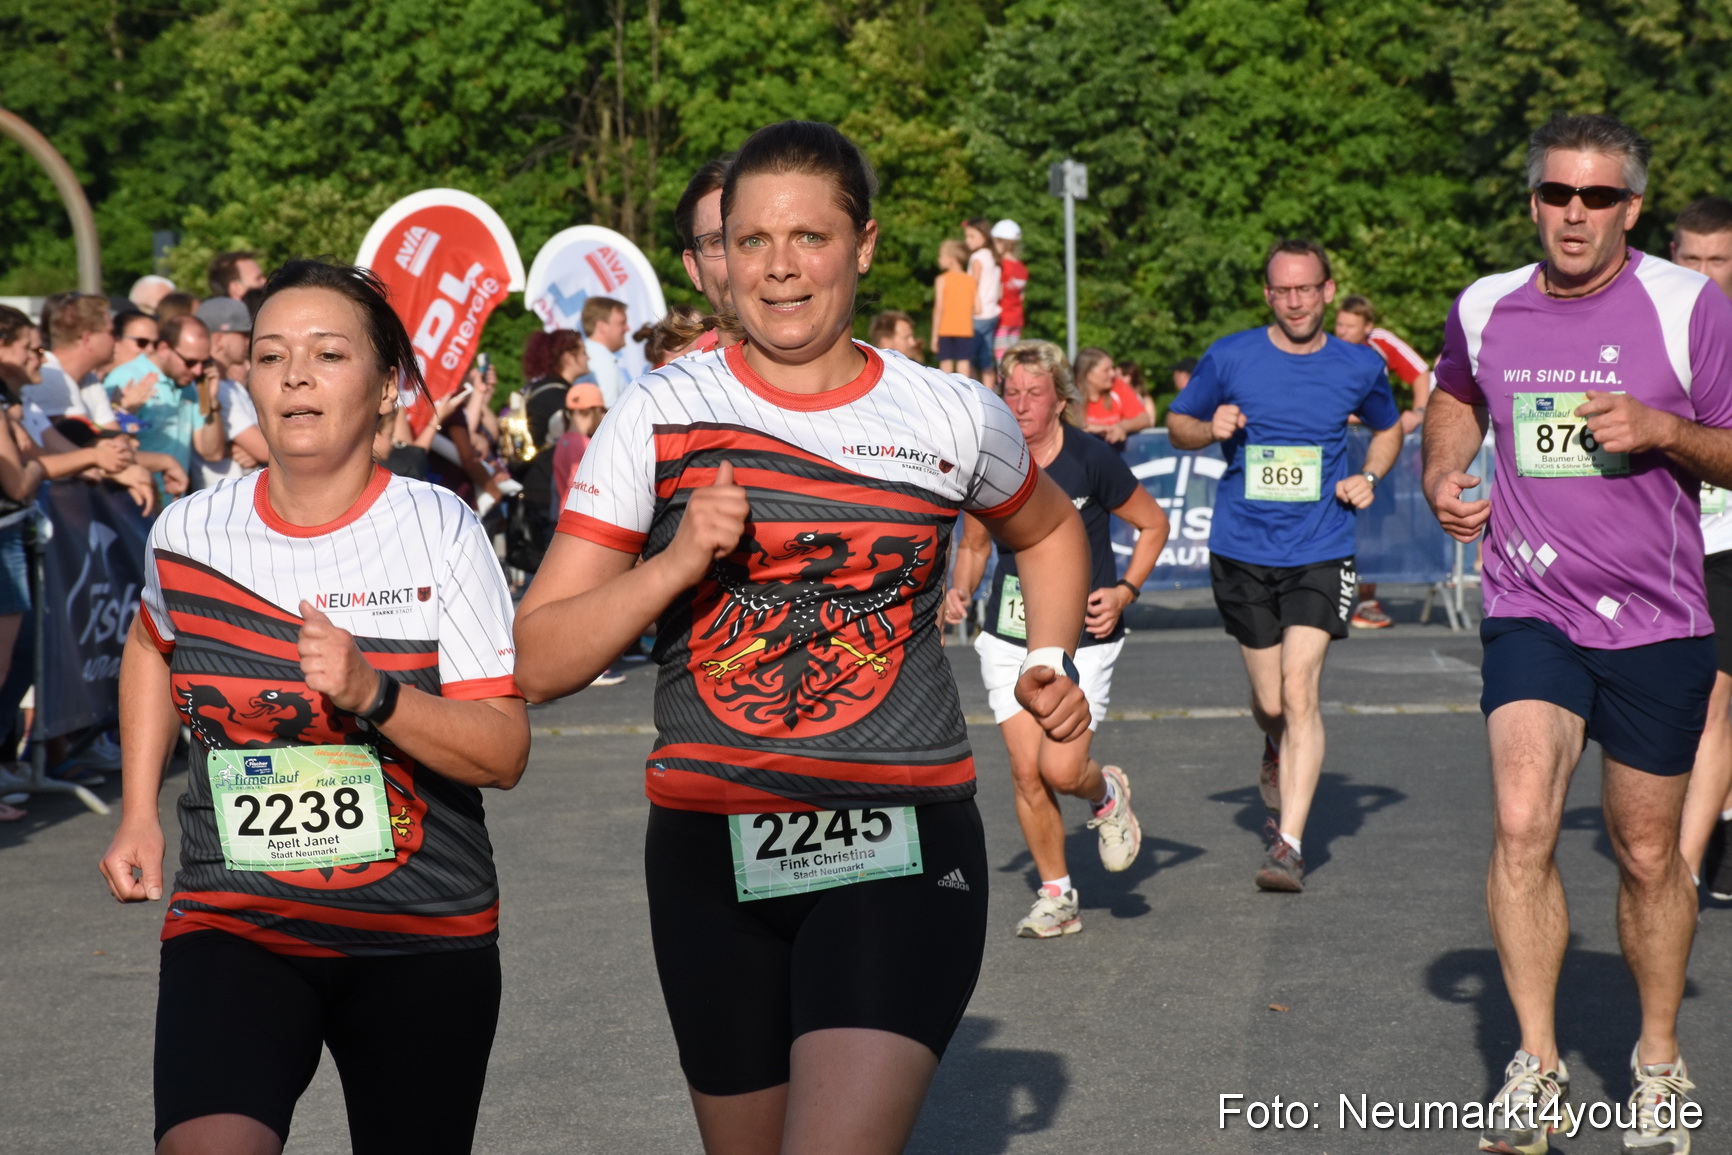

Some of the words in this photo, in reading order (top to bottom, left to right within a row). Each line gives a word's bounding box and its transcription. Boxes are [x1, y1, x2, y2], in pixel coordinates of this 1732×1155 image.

[395, 225, 427, 271] AVIA
[1503, 369, 1531, 382] WIR
[1536, 369, 1576, 382] SIND
[1580, 370, 1622, 384] LILA.
[1536, 424, 1600, 453] 876
[1541, 454, 1575, 463] Baumer
[1577, 453, 1597, 462] Uwe
[1262, 466, 1303, 485] 869
[316, 588, 413, 608] NEUMARKT
[1339, 568, 1356, 622] NIKE
[235, 771, 299, 785] firmenlauf
[341, 774, 371, 786] 2019
[234, 787, 364, 836] 2238
[267, 838, 300, 851] Apelt
[304, 835, 340, 847] Janet
[752, 811, 893, 860] 2245
[271, 851, 293, 859] Stadt
[295, 847, 338, 857] Neumarkt
[780, 857, 810, 871] Fink
[813, 849, 876, 866] Christina
[793, 869, 818, 880] Stadt
[819, 863, 865, 877] Neumarkt
[937, 879, 970, 891] adidas
